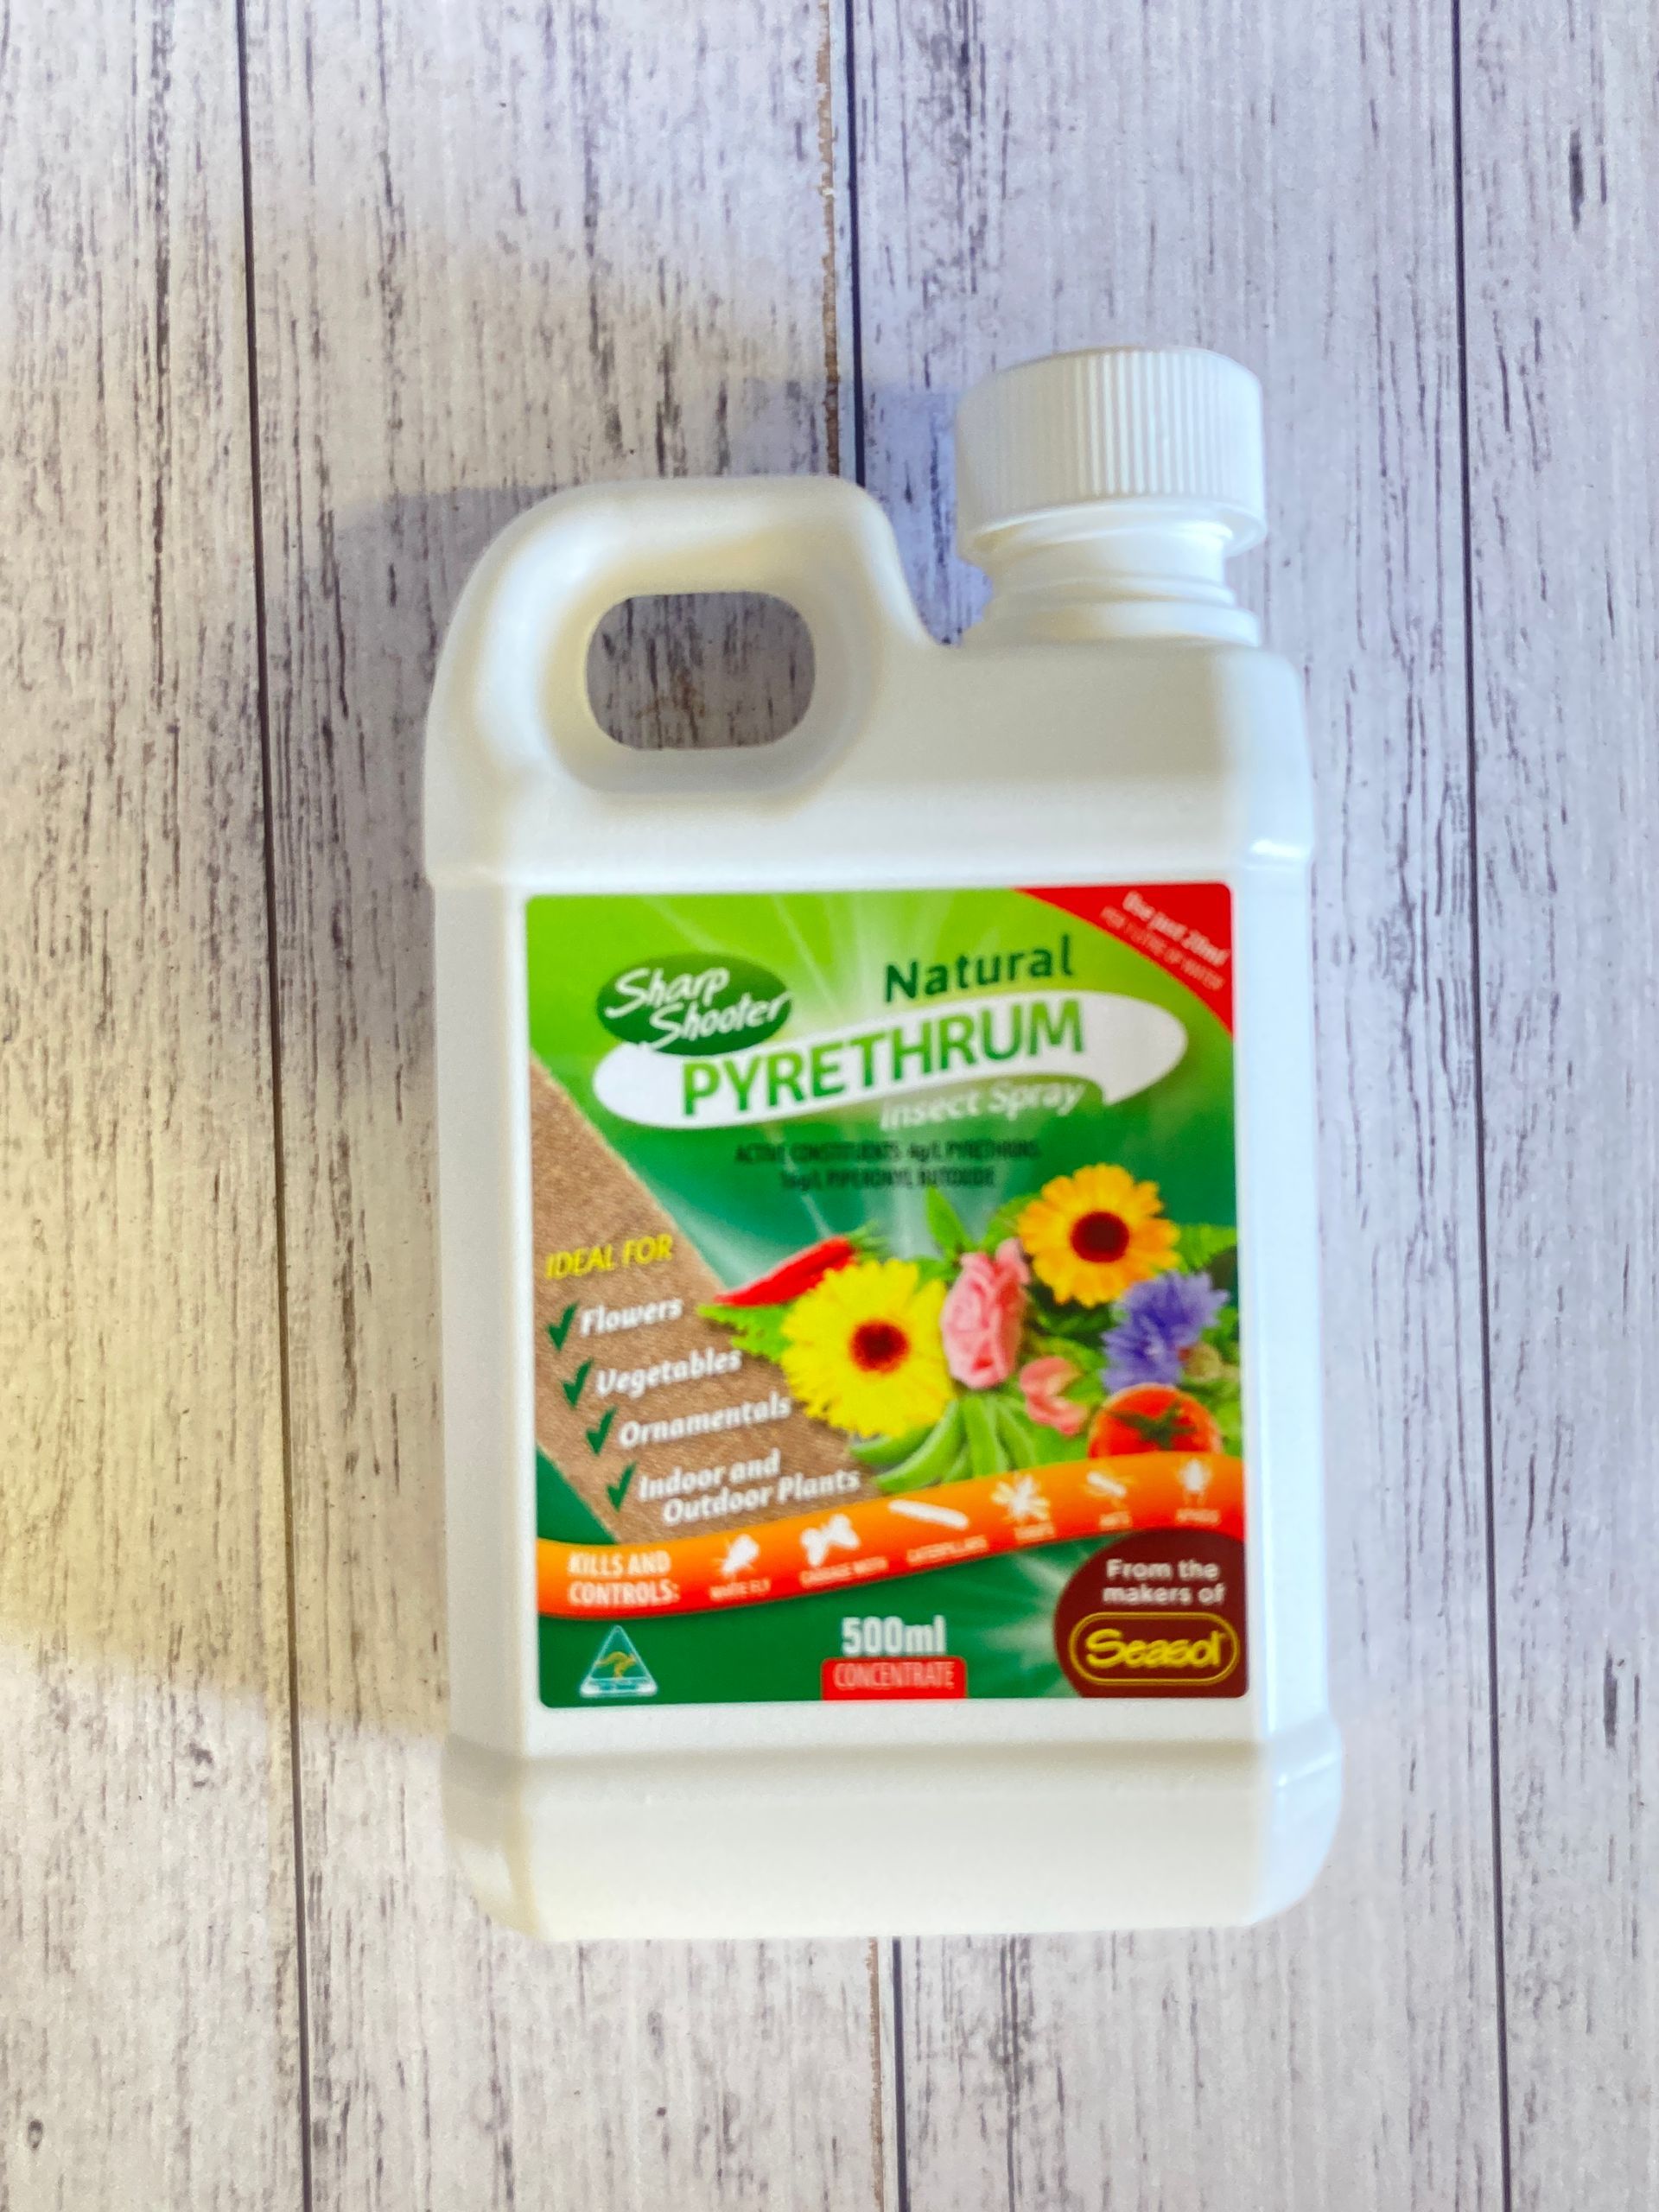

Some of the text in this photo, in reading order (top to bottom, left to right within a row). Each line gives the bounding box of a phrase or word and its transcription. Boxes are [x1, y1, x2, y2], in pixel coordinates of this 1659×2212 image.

[605, 967, 730, 1018] Sharp
[884, 934, 1075, 1003] Natural
[645, 992, 796, 1051] Shooter
[683, 998, 1085, 1116] PYRETHRUM
[880, 1082, 1086, 1131] Insect Spray
[545, 1234, 673, 1279] IDEAL FOR
[580, 1298, 683, 1338] Flowers
[595, 1346, 743, 1399] Vegetables
[619, 1390, 791, 1448] Ornamentals
[639, 1447, 781, 1502] Indoor and
[663, 1469, 861, 1525] Outdoor Plants
[568, 1550, 671, 1578] KILLS AND
[1106, 1558, 1220, 1580] From the
[1103, 1582, 1227, 1605] makers of
[841, 1615, 947, 1657] 500ml
[1085, 1628, 1226, 1669] Seasol
[833, 1661, 956, 1691] CONCENTRATE
